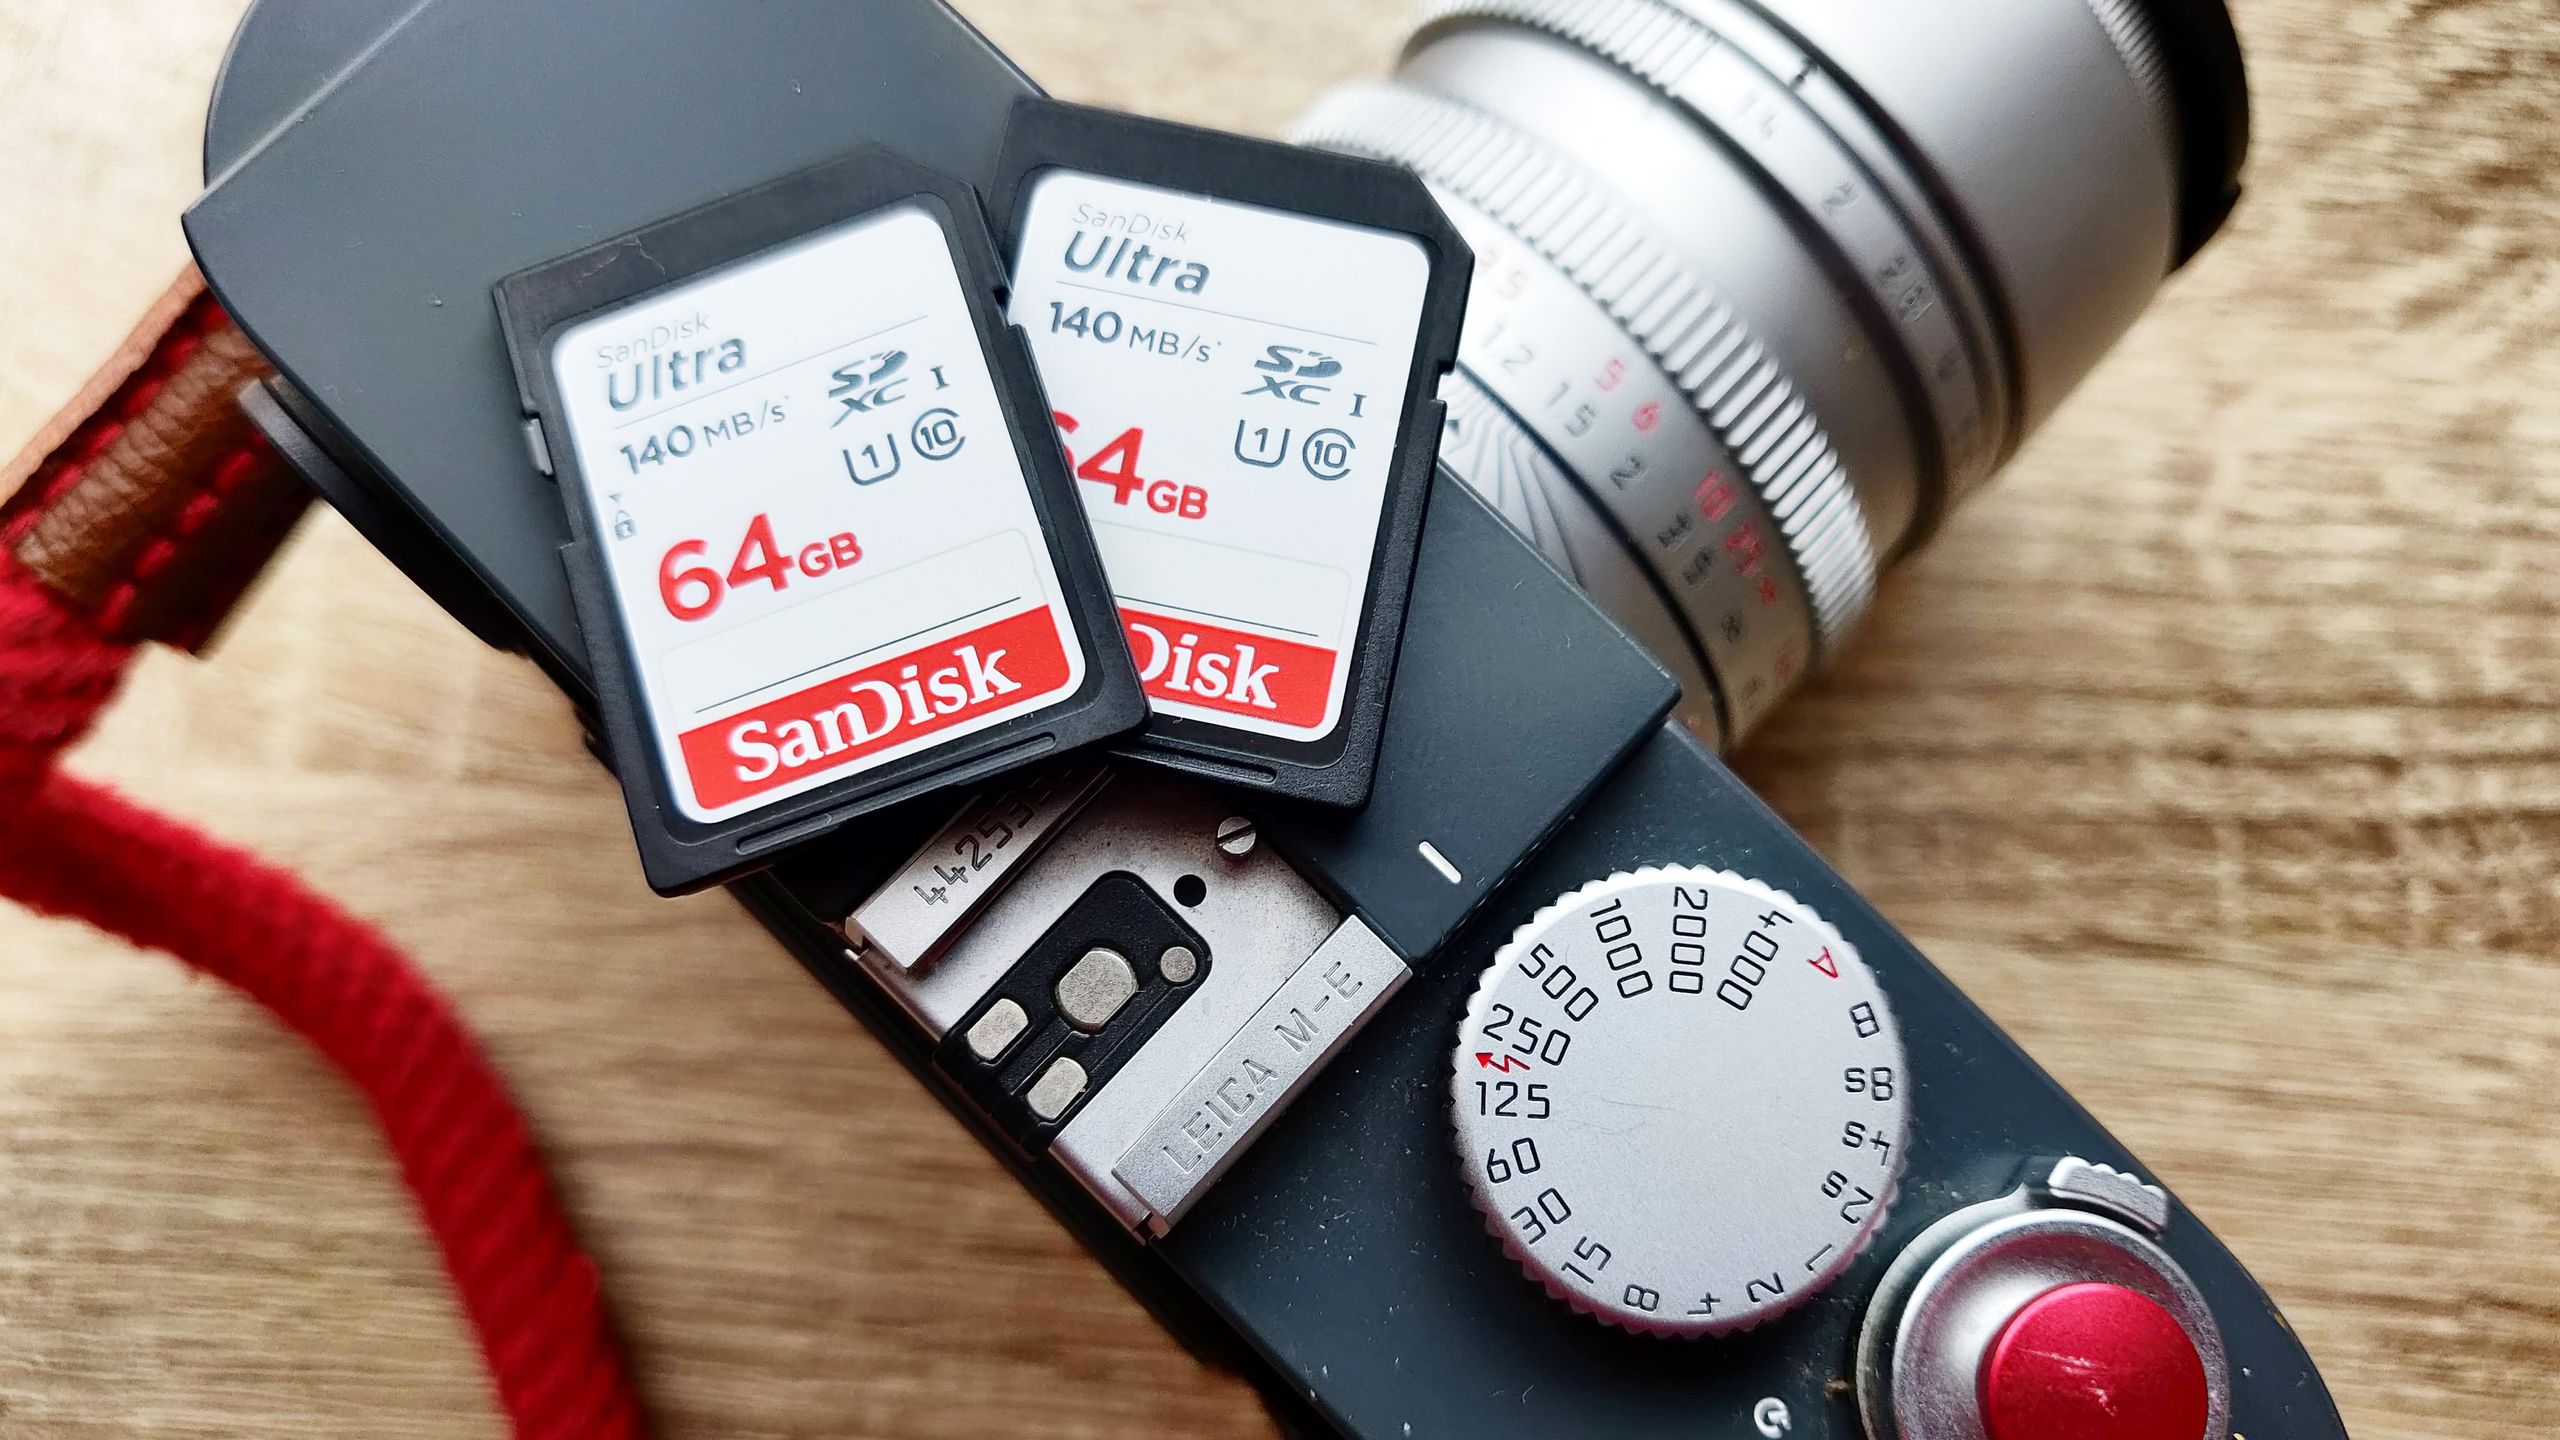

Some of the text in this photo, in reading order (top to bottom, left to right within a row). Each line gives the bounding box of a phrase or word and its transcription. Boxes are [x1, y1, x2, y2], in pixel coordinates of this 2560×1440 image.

[1072, 203, 1192, 243] SanDisk
[1064, 230, 1211, 295] Ultra
[596, 311, 711, 368] SanDisk
[1050, 301, 1123, 344] 140
[608, 337, 747, 412] Ultra
[620, 425, 697, 475] 140
[658, 512, 864, 622] 64GB
[1129, 623, 1280, 709] Disk
[727, 644, 1022, 783] SanDisk
[1590, 898, 1653, 999] 1000
[1669, 886, 1709, 995] 2000
[1717, 909, 1794, 1011] 4000
[1807, 946, 1839, 980] A
[1518, 943, 1599, 1022] 500
[1482, 1004, 1571, 1066] 250
[1162, 960, 1364, 1174] LEICA M-E
[1475, 1081, 1551, 1120] 125
[1486, 1138, 1541, 1184] 60
[1510, 1188, 1572, 1245] 30
[1561, 1235, 1612, 1284] 15
[1745, 1272, 1785, 1304] 2
[1687, 1292, 1722, 1317] 4
